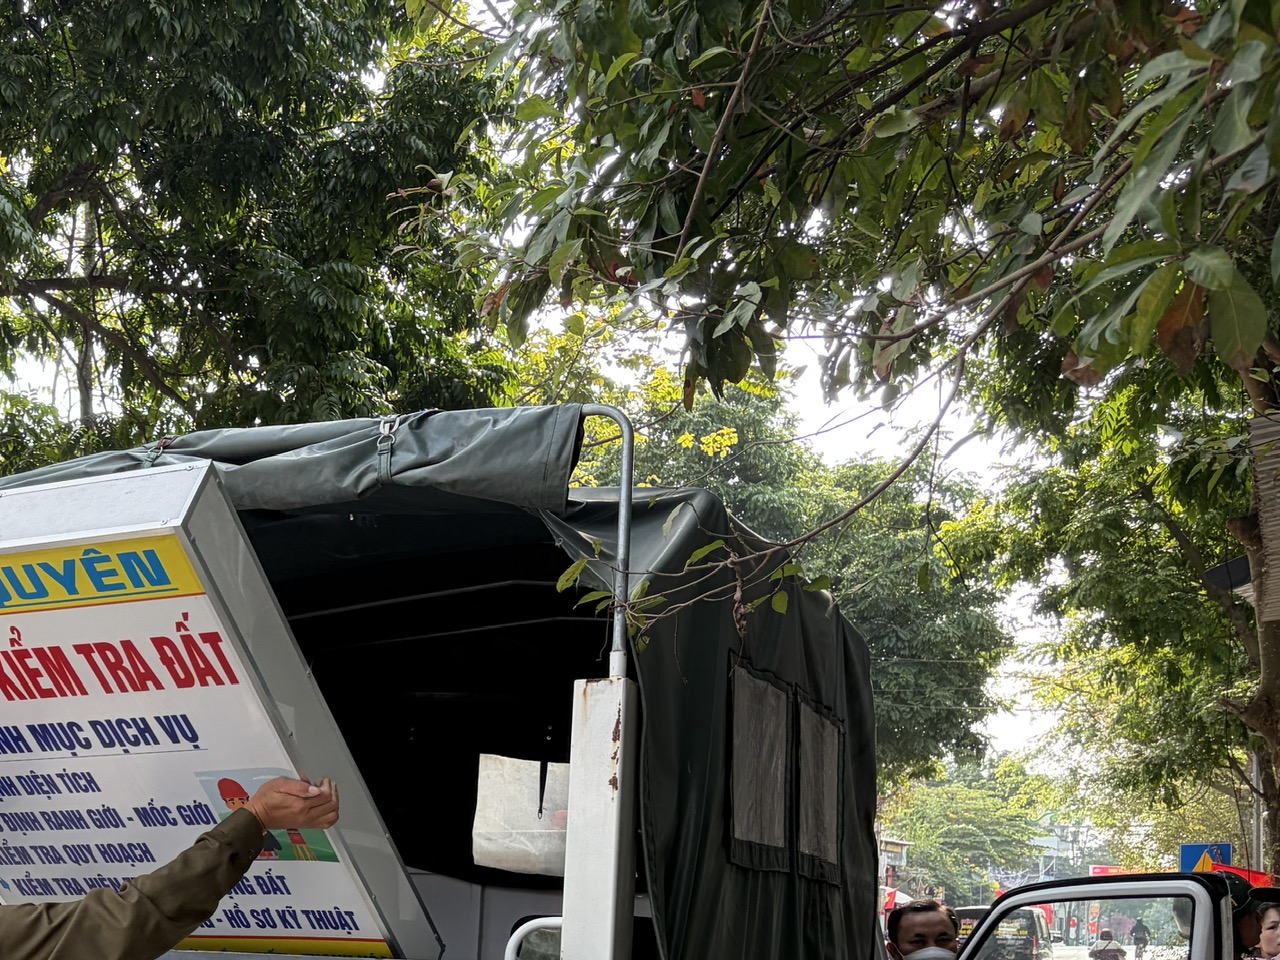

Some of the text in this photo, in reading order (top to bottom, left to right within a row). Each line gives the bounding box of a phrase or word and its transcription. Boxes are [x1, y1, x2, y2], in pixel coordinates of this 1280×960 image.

[72, 639, 162, 694] TRA
[149, 612, 240, 688] ĐẤT
[25, 721, 92, 757] MỤC
[89, 717, 159, 755] DỊCH
[153, 713, 200, 750] VỤ
[16, 770, 59, 800] DIỆN
[56, 768, 102, 793] TÍCH
[0, 811, 41, 836] ĐỊNH
[39, 809, 90, 831] RANH
[86, 804, 127, 828] GIỚI
[133, 798, 178, 827] MỐC
[175, 799, 218, 826] GIỚI
[29, 845, 67, 864] TRA
[62, 844, 98, 866] QUY
[95, 843, 157, 867] HOẠCH
[11, 871, 58, 896] KIỂM
[53, 878, 88, 895] TRA
[253, 868, 292, 895] ĐẤT
[222, 903, 251, 929] HỒ
[250, 907, 278, 930] SƠ
[275, 905, 302, 929] KỸ
[301, 906, 361, 935] THUẬT
